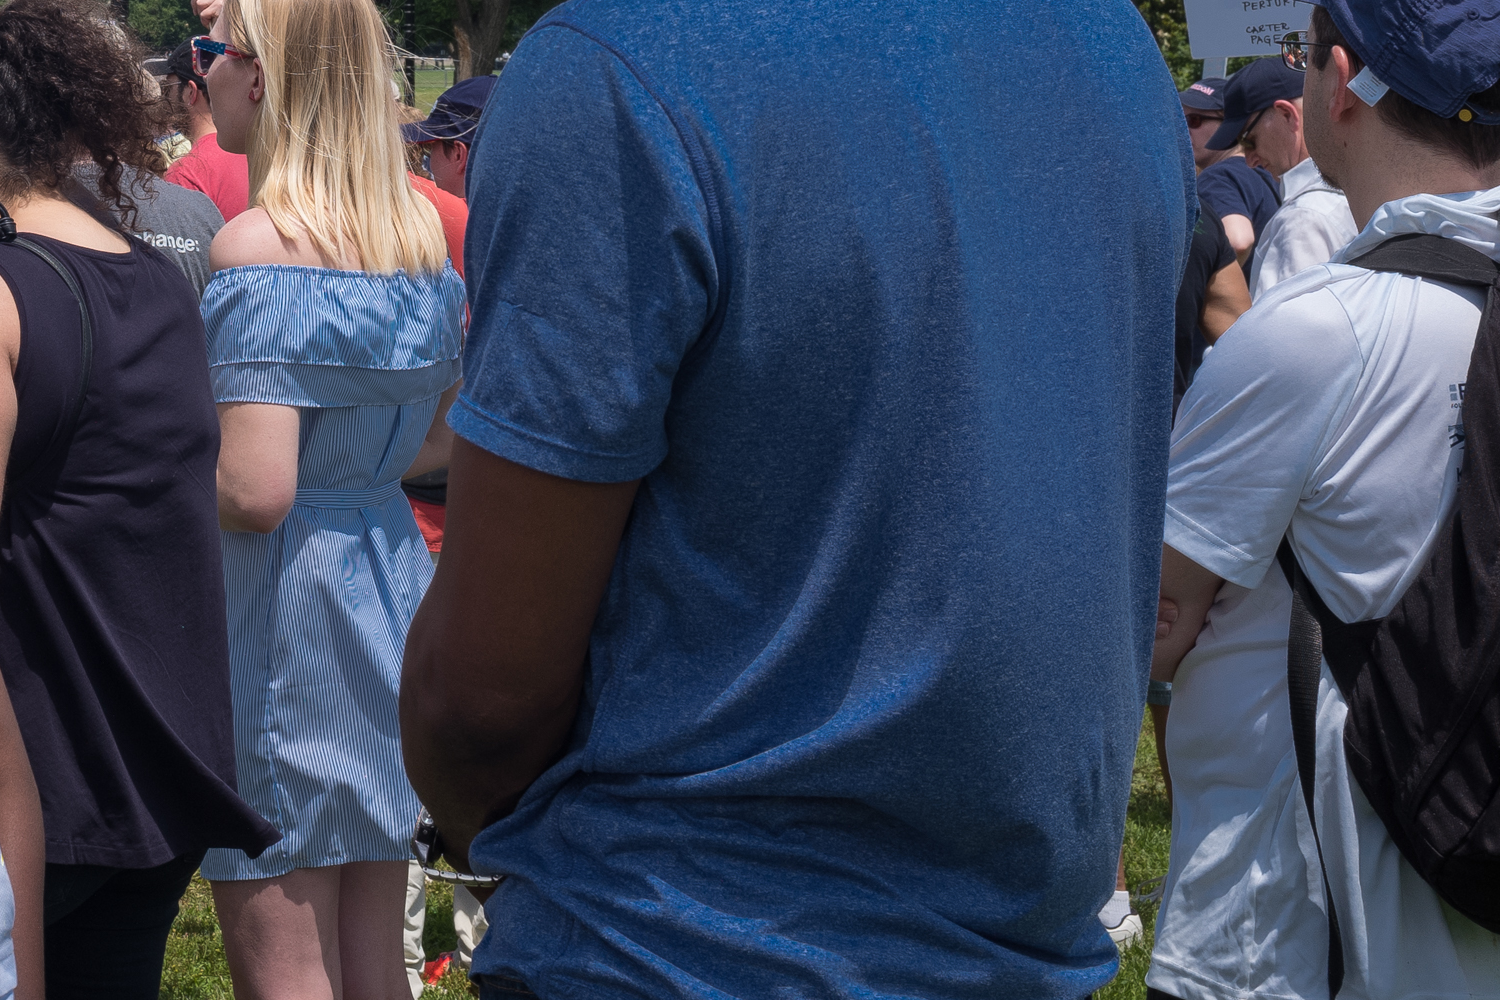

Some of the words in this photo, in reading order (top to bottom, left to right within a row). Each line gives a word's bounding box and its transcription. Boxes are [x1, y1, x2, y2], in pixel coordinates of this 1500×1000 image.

[1246, 22, 1290, 34] CARTER
[1250, 33, 1282, 46] PAGE
[134, 231, 200, 253] hange:
